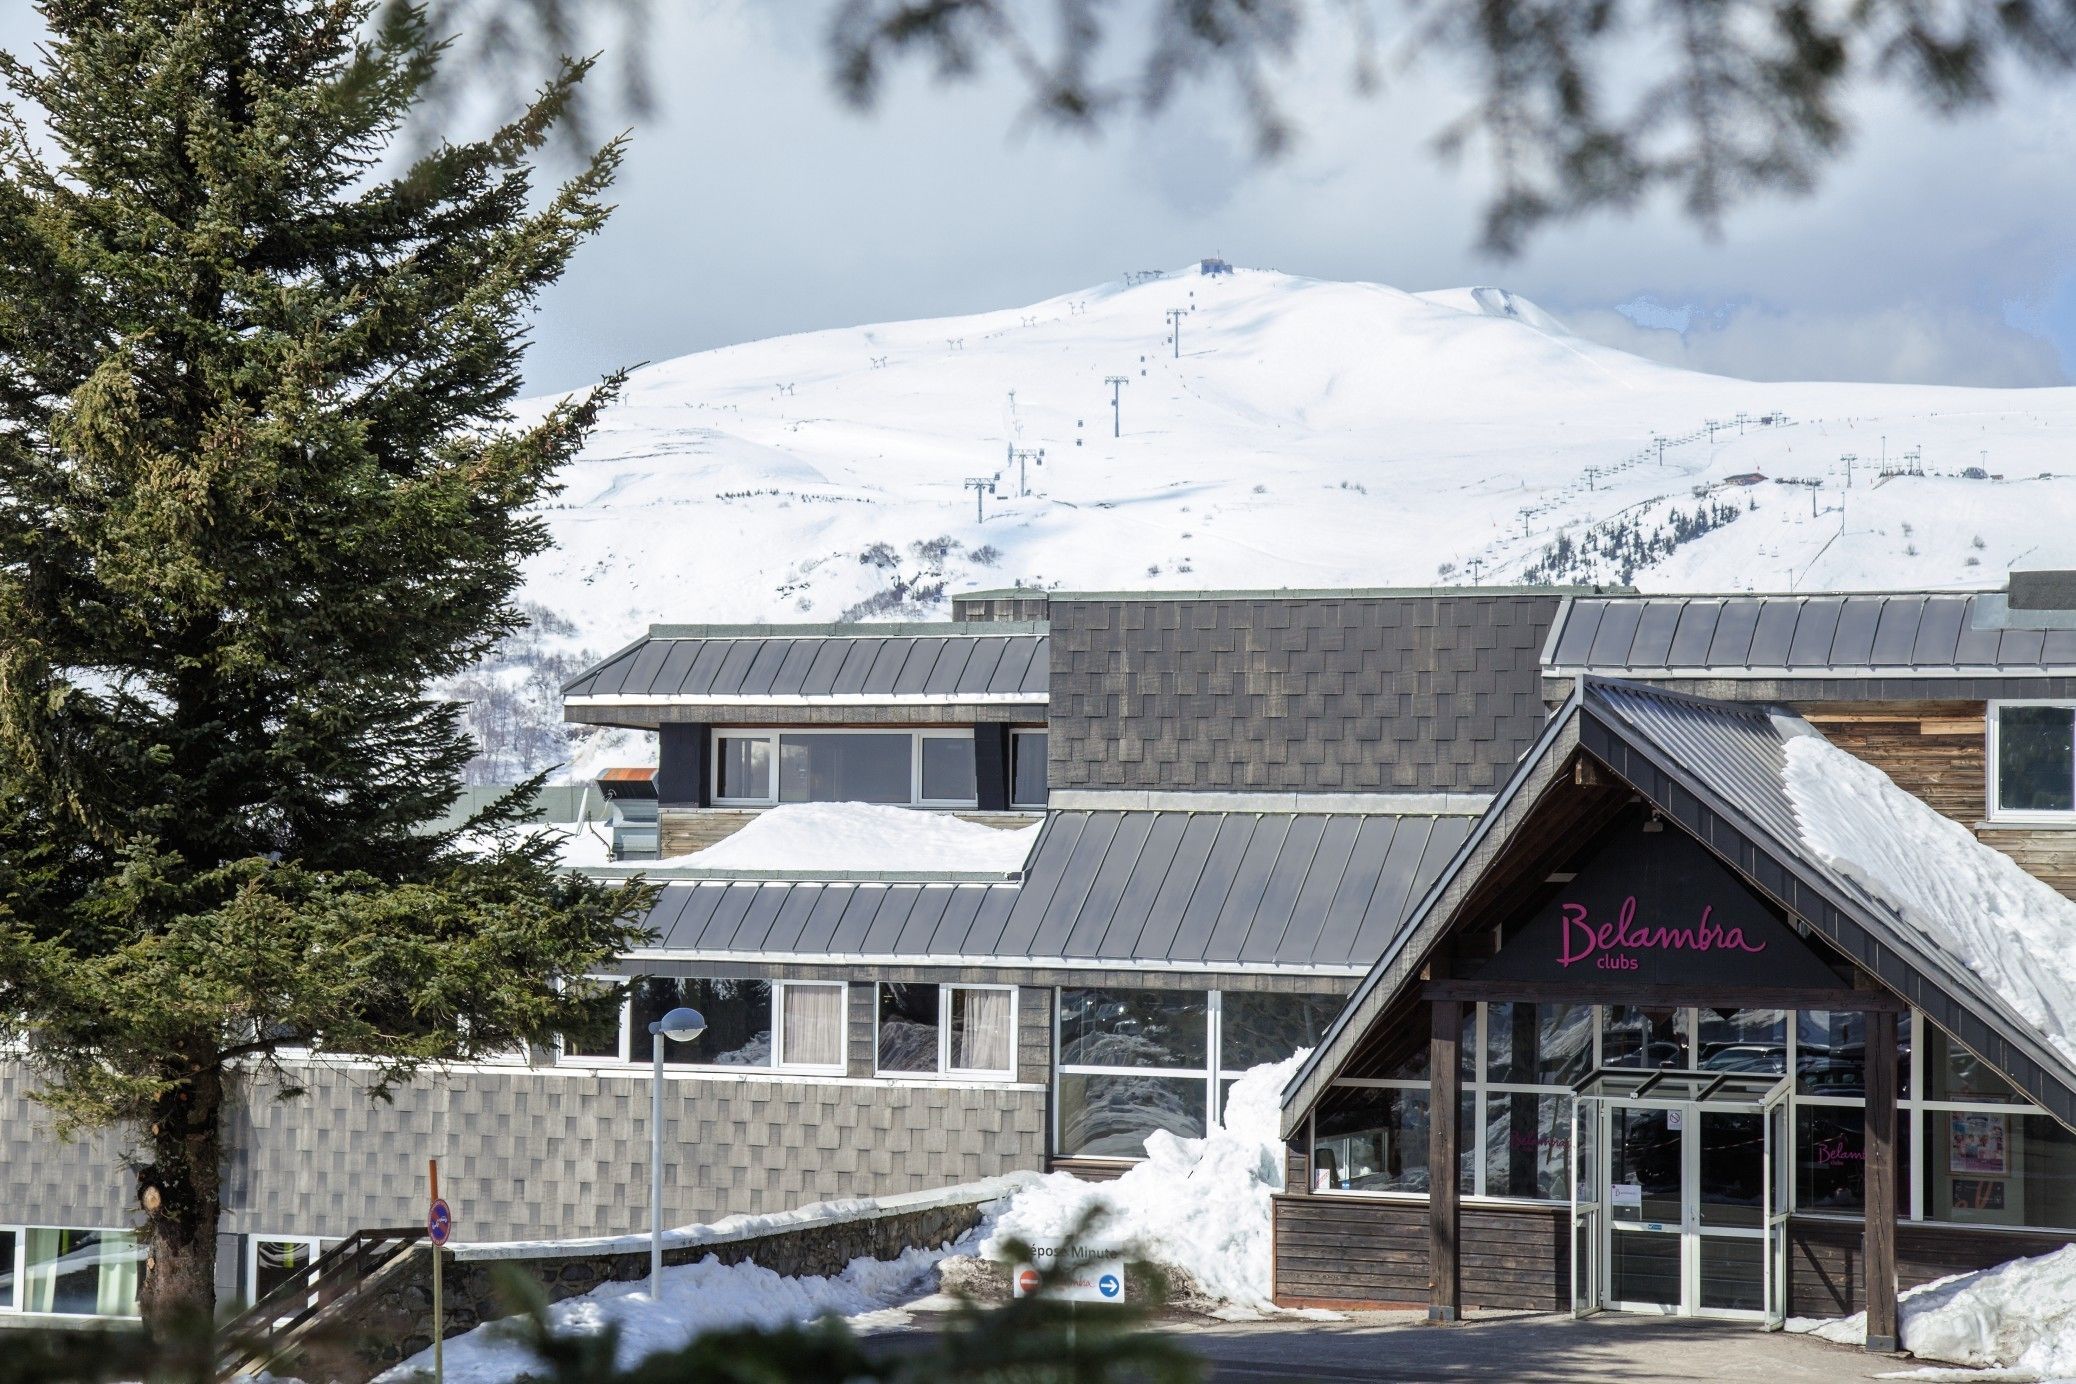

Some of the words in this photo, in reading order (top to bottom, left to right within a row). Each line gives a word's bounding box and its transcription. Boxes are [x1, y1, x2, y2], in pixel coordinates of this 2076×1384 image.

[1555, 896, 1766, 967] Belambra
[1596, 954, 1639, 970] clubs
[1029, 1243, 1068, 1258] épose
[1071, 1245, 1117, 1259] Minute
